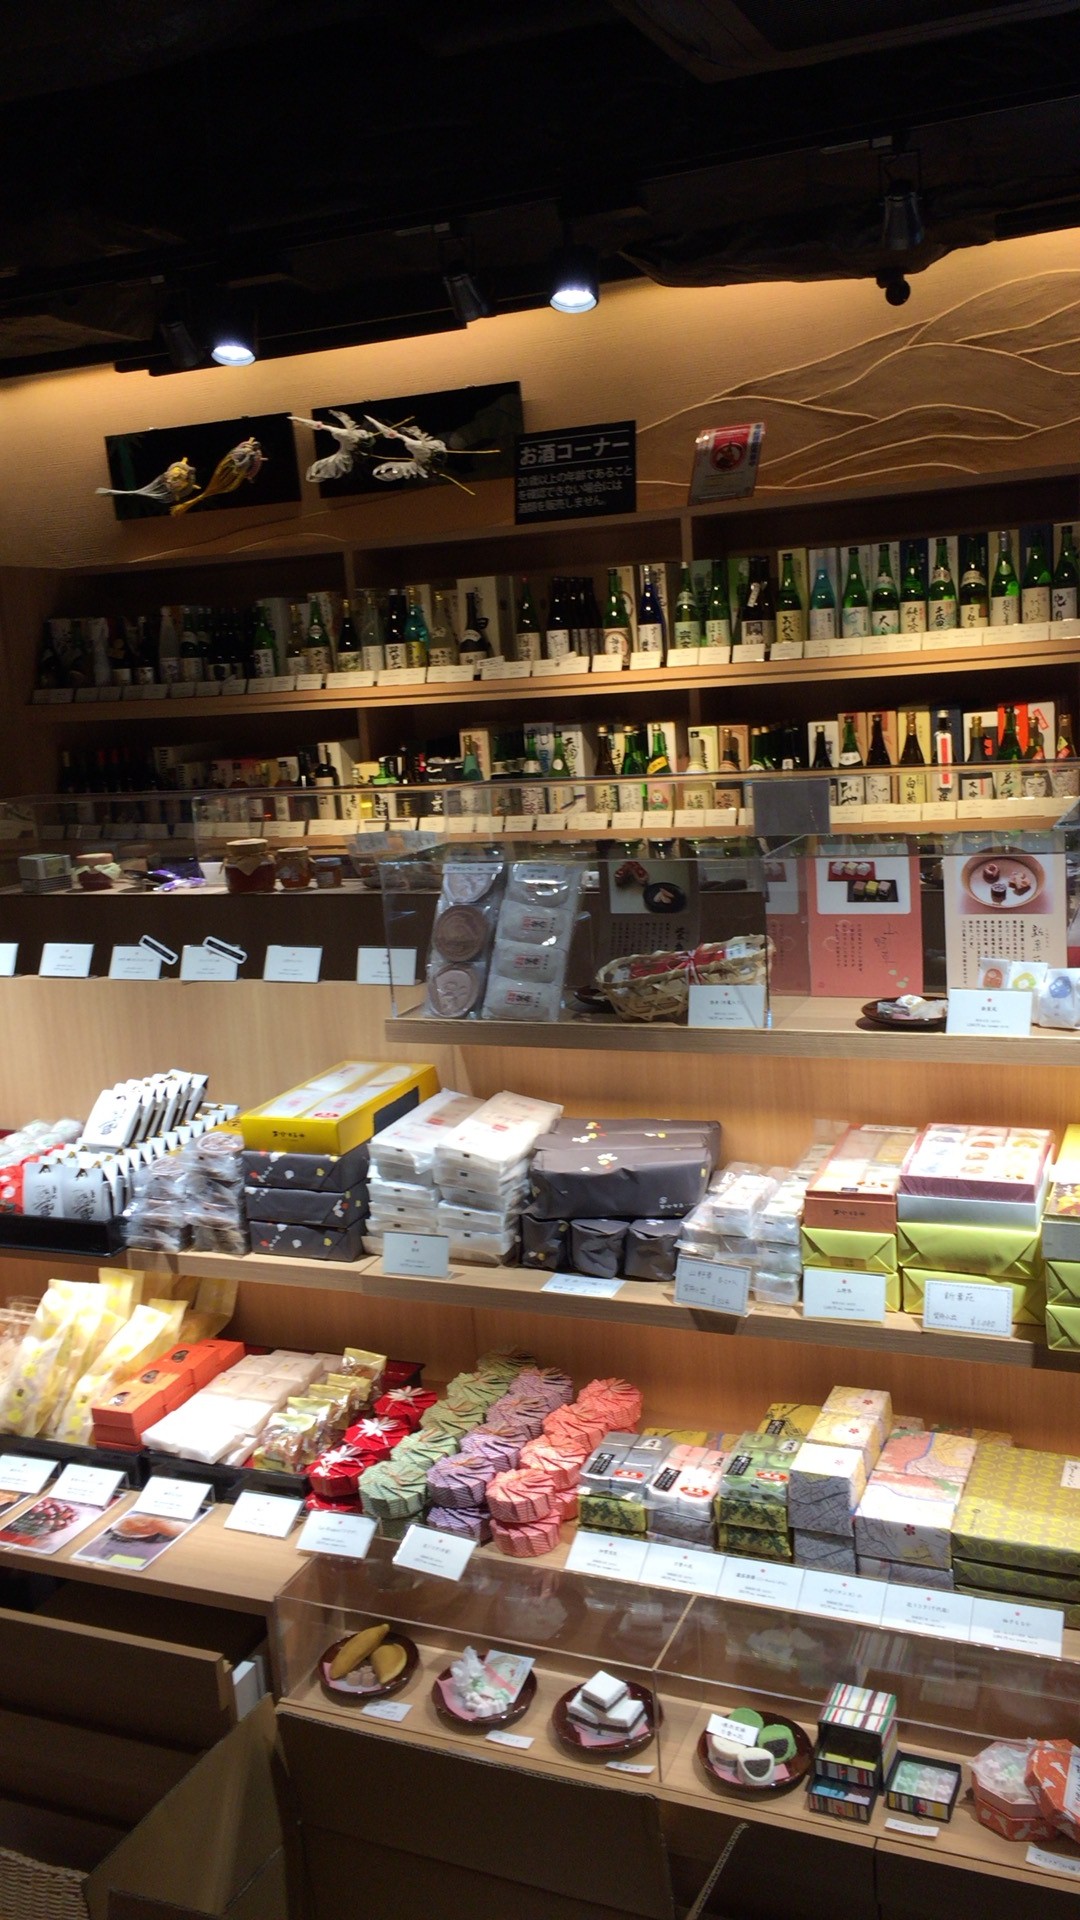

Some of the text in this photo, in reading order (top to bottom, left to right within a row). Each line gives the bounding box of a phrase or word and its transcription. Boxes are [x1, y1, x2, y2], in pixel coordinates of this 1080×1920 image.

[519, 437, 630, 466] お酒コーナー
